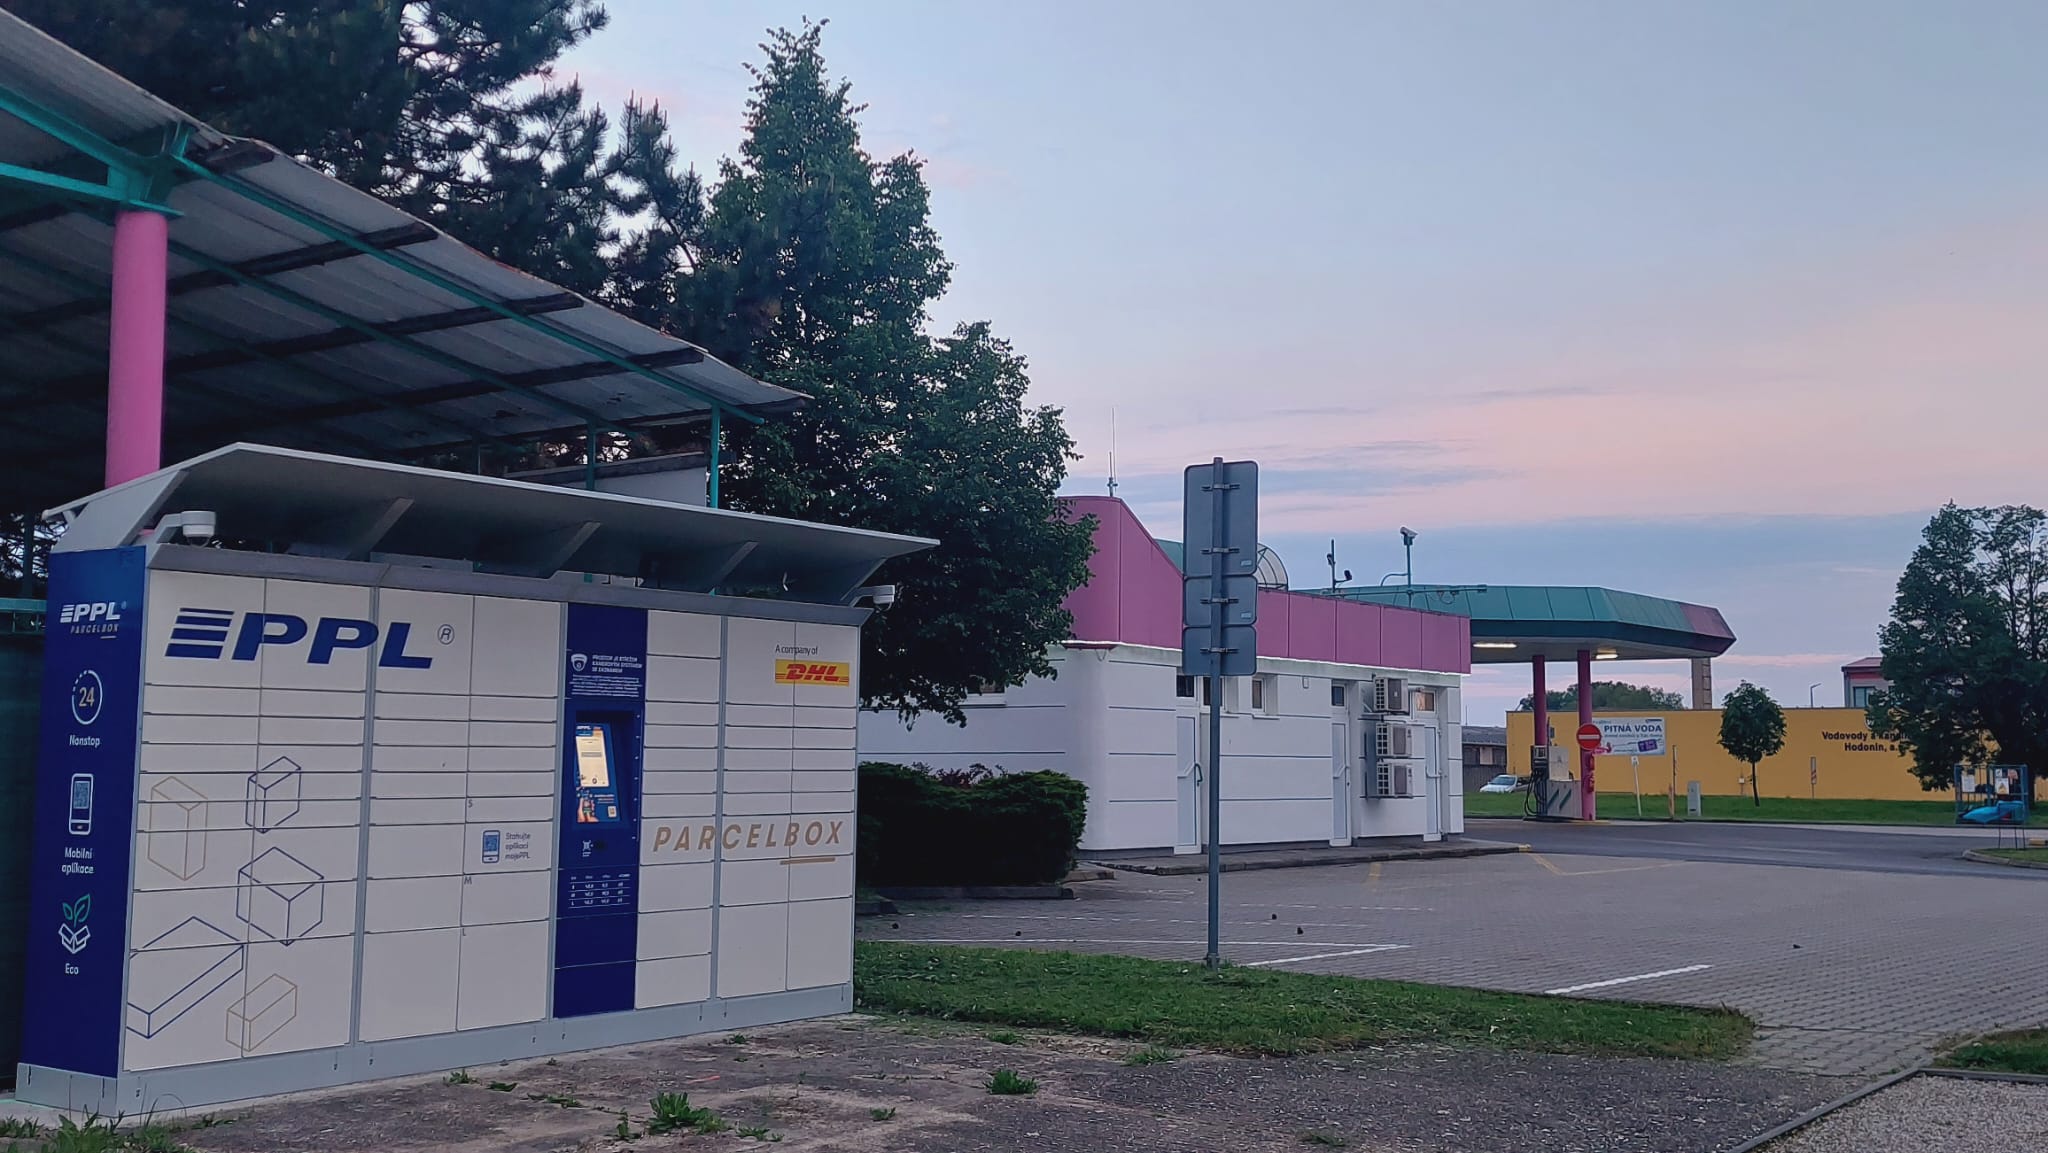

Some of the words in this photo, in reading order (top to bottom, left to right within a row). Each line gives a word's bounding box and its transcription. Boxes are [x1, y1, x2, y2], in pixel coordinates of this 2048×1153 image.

[73, 602, 120, 622] PPL
[231, 612, 433, 669] PPL
[775, 644, 780, 653] A
[781, 646, 811, 656] company
[812, 646, 818, 655] of
[785, 664, 840, 682] DHL
[79, 687, 95, 707] 24
[1604, 723, 1632, 732] PITNÁ
[1634, 724, 1662, 732] VODA
[69, 734, 100, 748] Nonstop
[1822, 731, 1868, 741] Vodovody
[468, 800, 473, 808] S
[653, 821, 844, 852] PARCELBOX
[64, 847, 93, 859] Mobilní
[61, 862, 95, 876] aplikace
[464, 876, 472, 885] M
[65, 963, 79, 975] Eco
